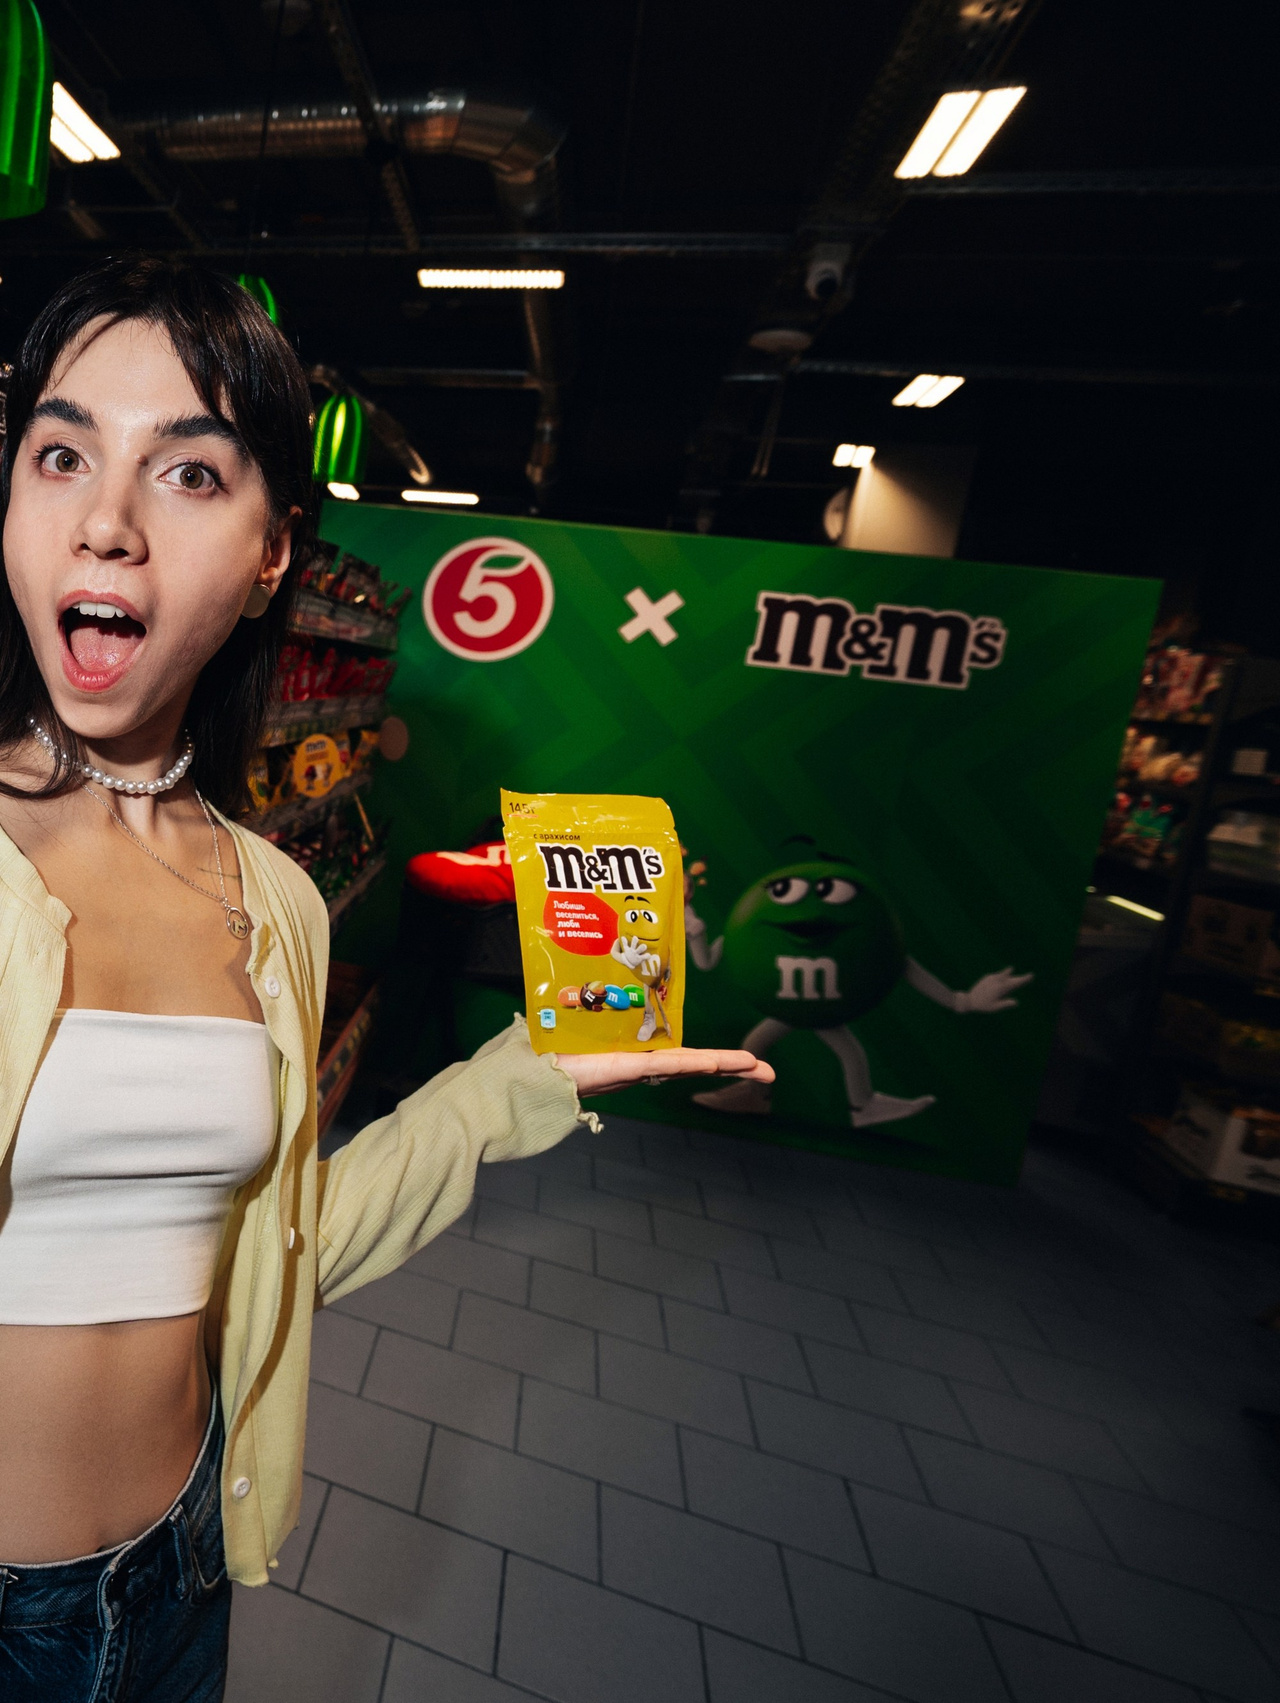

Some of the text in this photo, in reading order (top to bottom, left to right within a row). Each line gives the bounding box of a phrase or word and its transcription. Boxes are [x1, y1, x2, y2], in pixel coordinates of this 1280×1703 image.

[540, 833, 580, 842] арахисом
[553, 900, 585, 911] Любишь
[557, 920, 580, 929] люби
[567, 930, 603, 939] веселись
